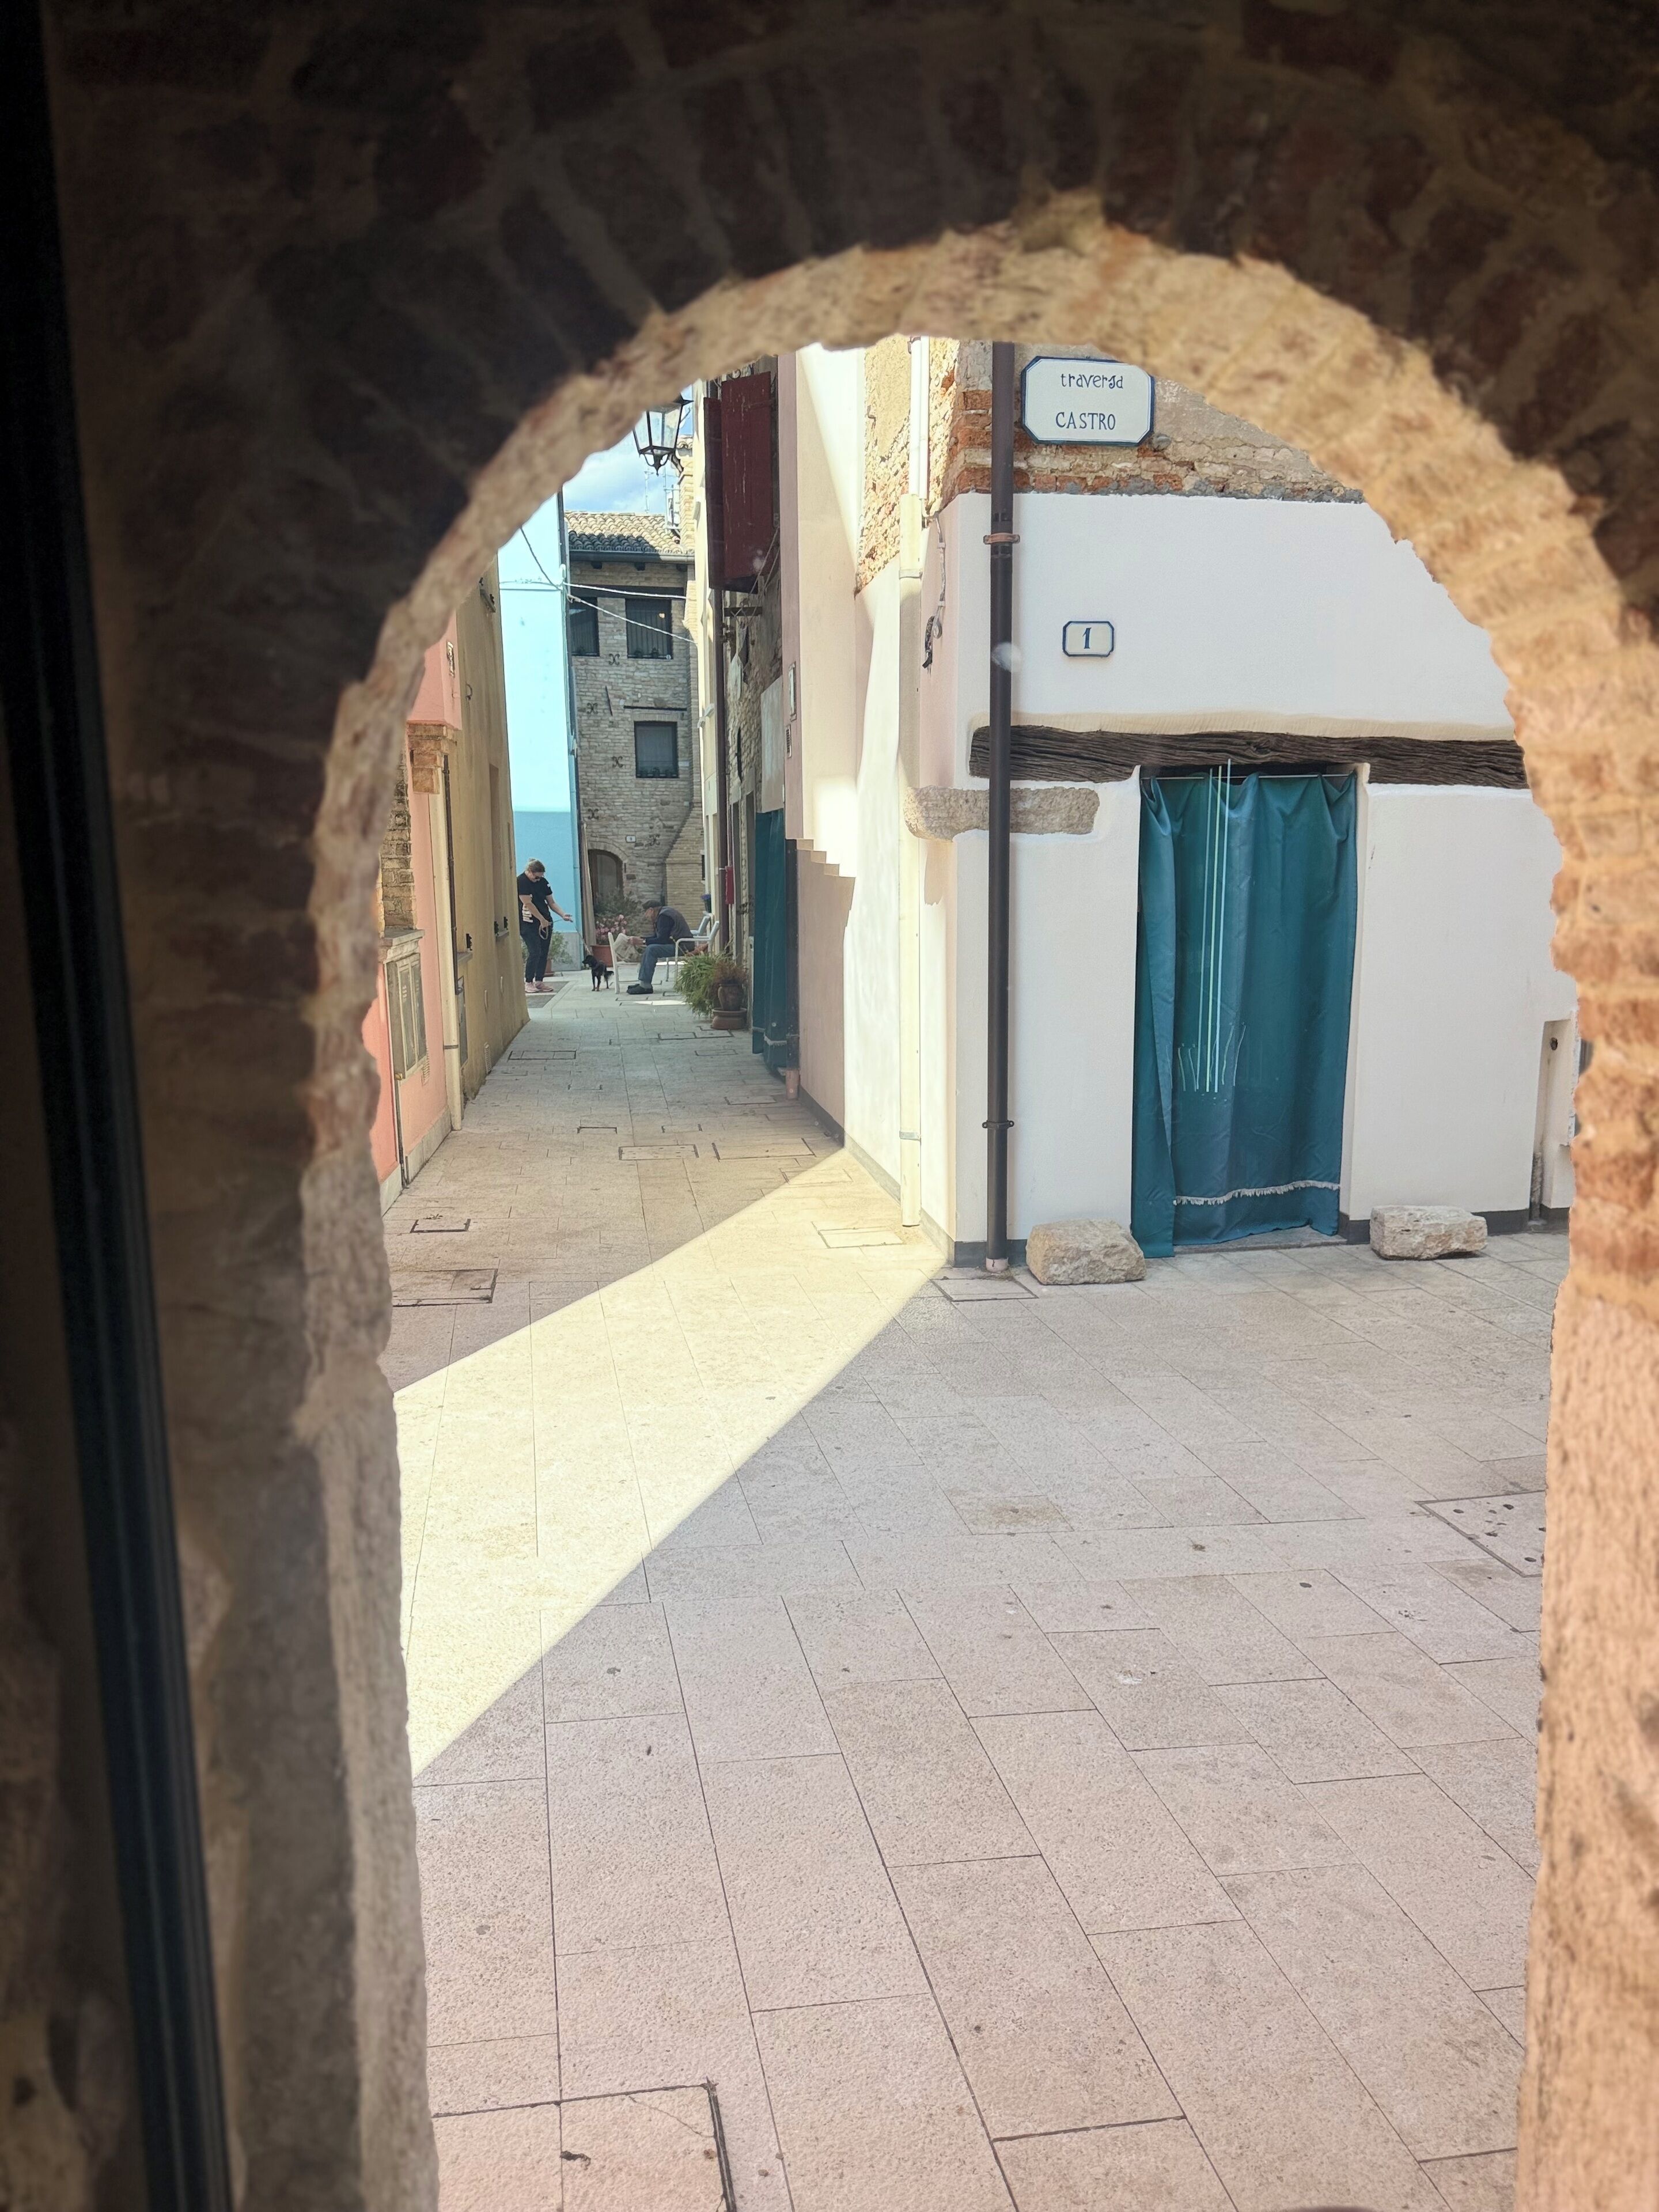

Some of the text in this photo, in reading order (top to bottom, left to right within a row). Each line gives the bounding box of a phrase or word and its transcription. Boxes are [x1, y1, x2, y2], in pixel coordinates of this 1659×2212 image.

[1060, 373, 1123, 389] traversa
[1056, 411, 1116, 430] CASTRO
[1082, 627, 1092, 649] 1
